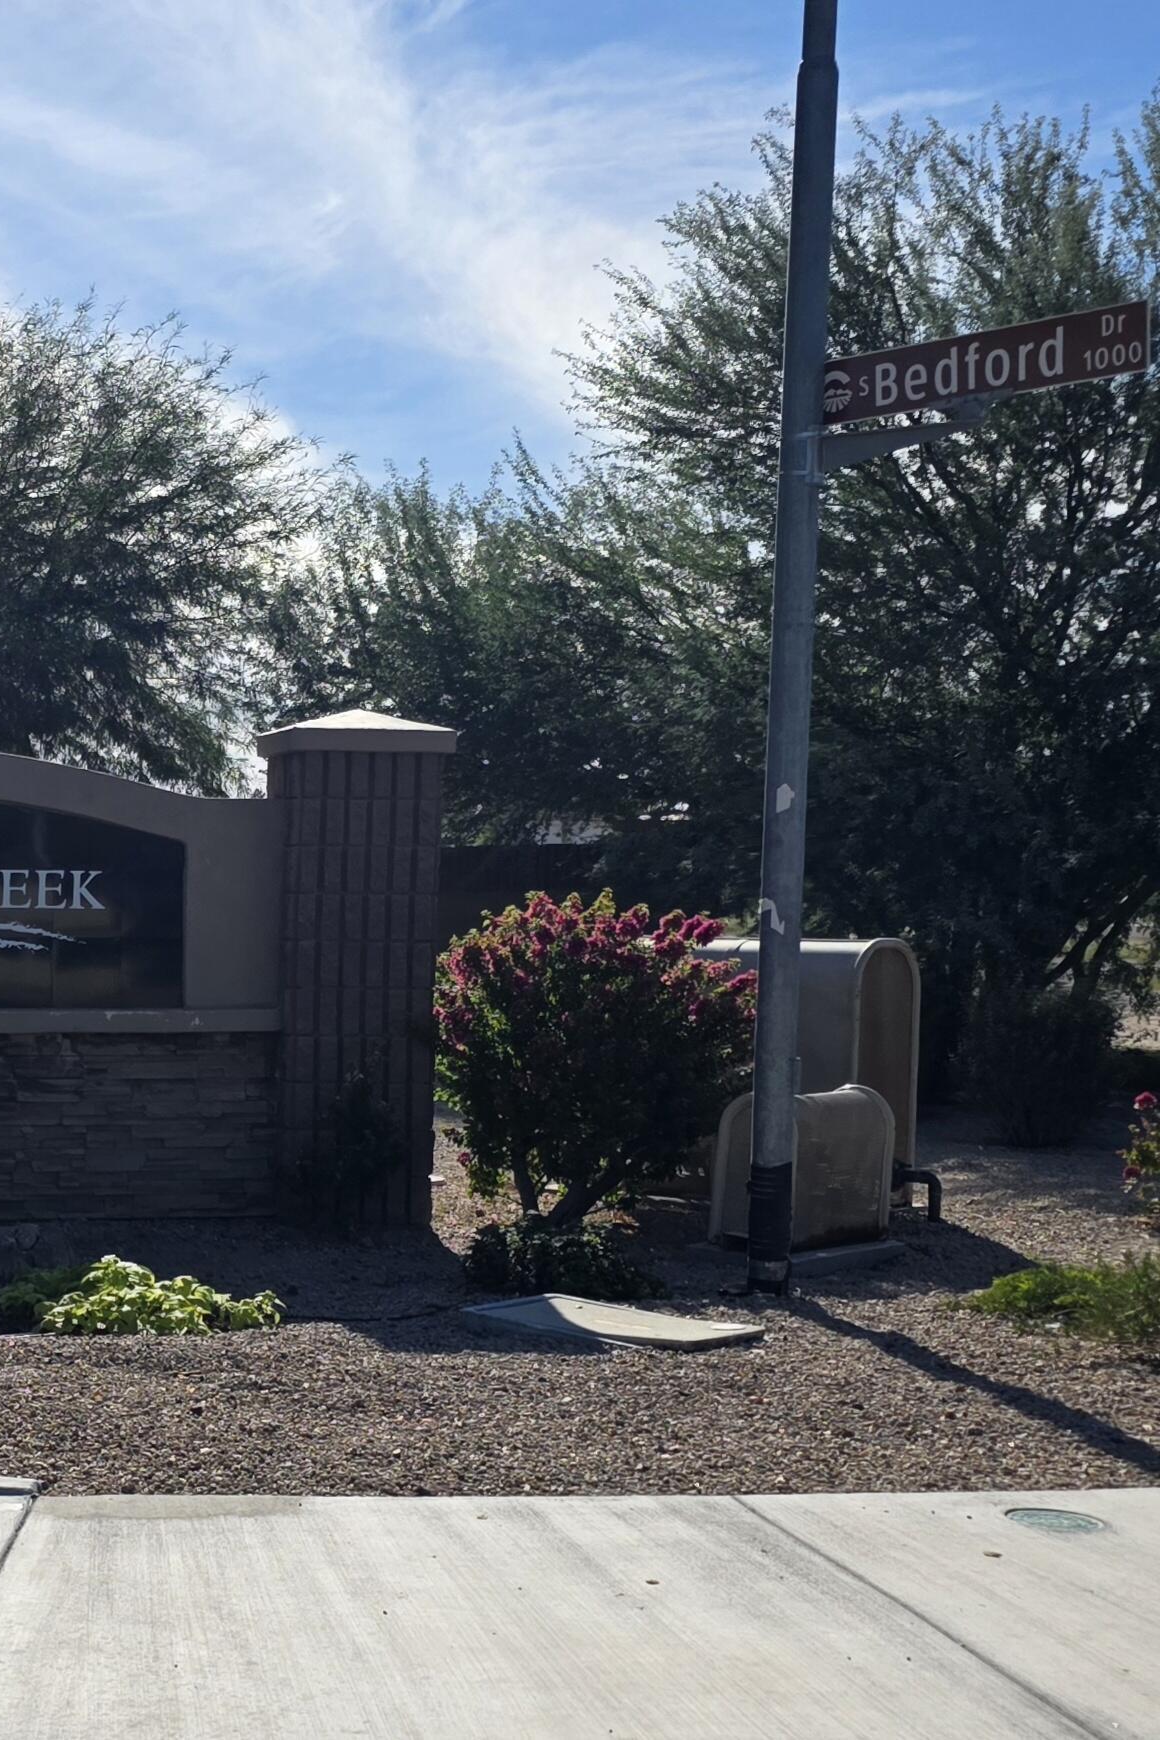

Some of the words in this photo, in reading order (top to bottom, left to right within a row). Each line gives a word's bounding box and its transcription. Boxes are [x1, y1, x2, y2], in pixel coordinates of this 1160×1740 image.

[1101, 314, 1127, 337] Dr
[874, 325, 1064, 406] Bedford
[1083, 341, 1142, 372] 1000
